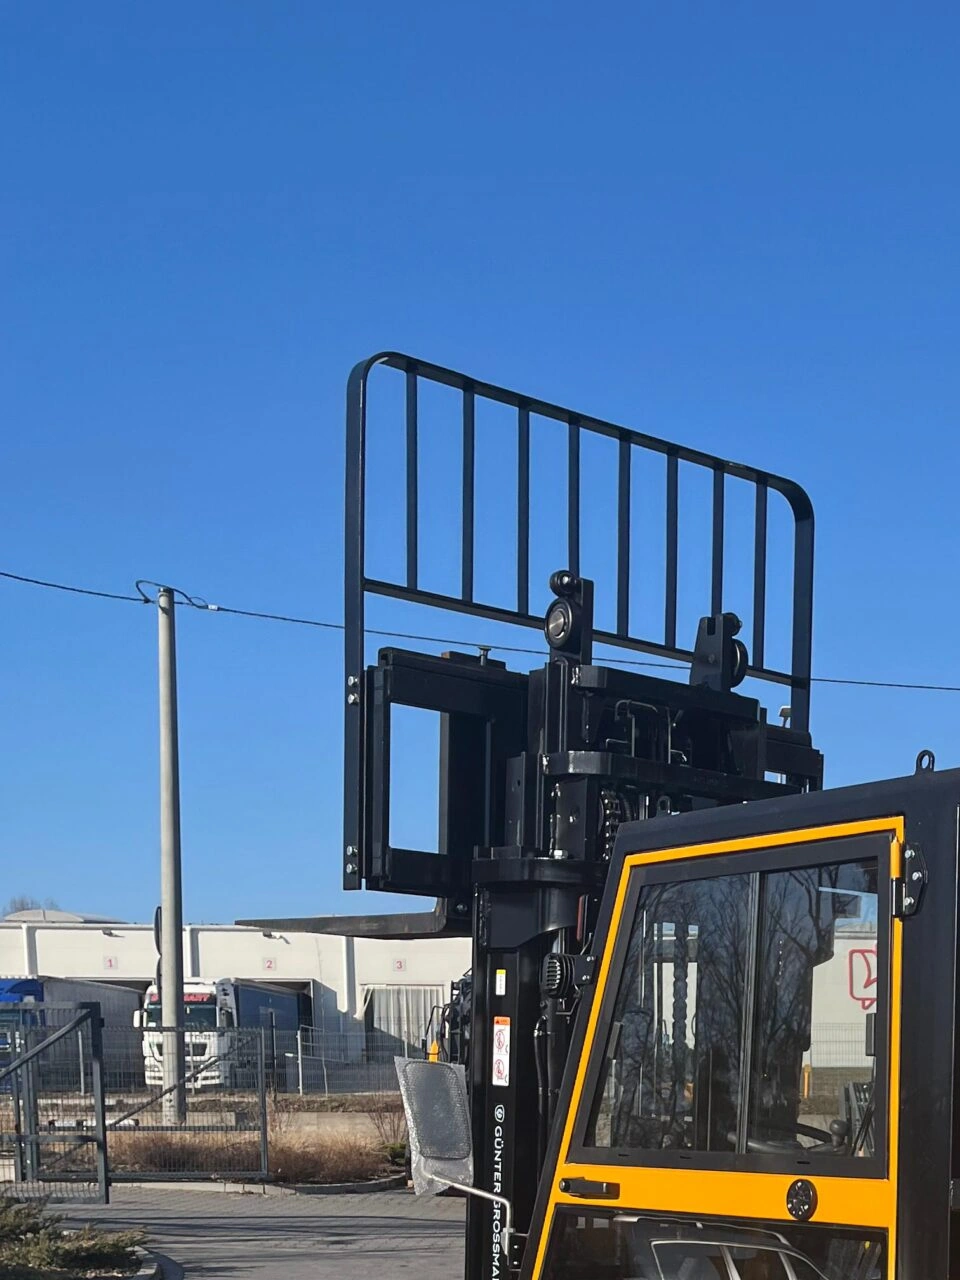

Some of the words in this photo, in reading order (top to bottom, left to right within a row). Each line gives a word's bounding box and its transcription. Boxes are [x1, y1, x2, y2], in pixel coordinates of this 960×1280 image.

[266, 959, 273, 969] 2
[396, 960, 403, 970] 3
[493, 1125, 504, 1193] GÜNTER
